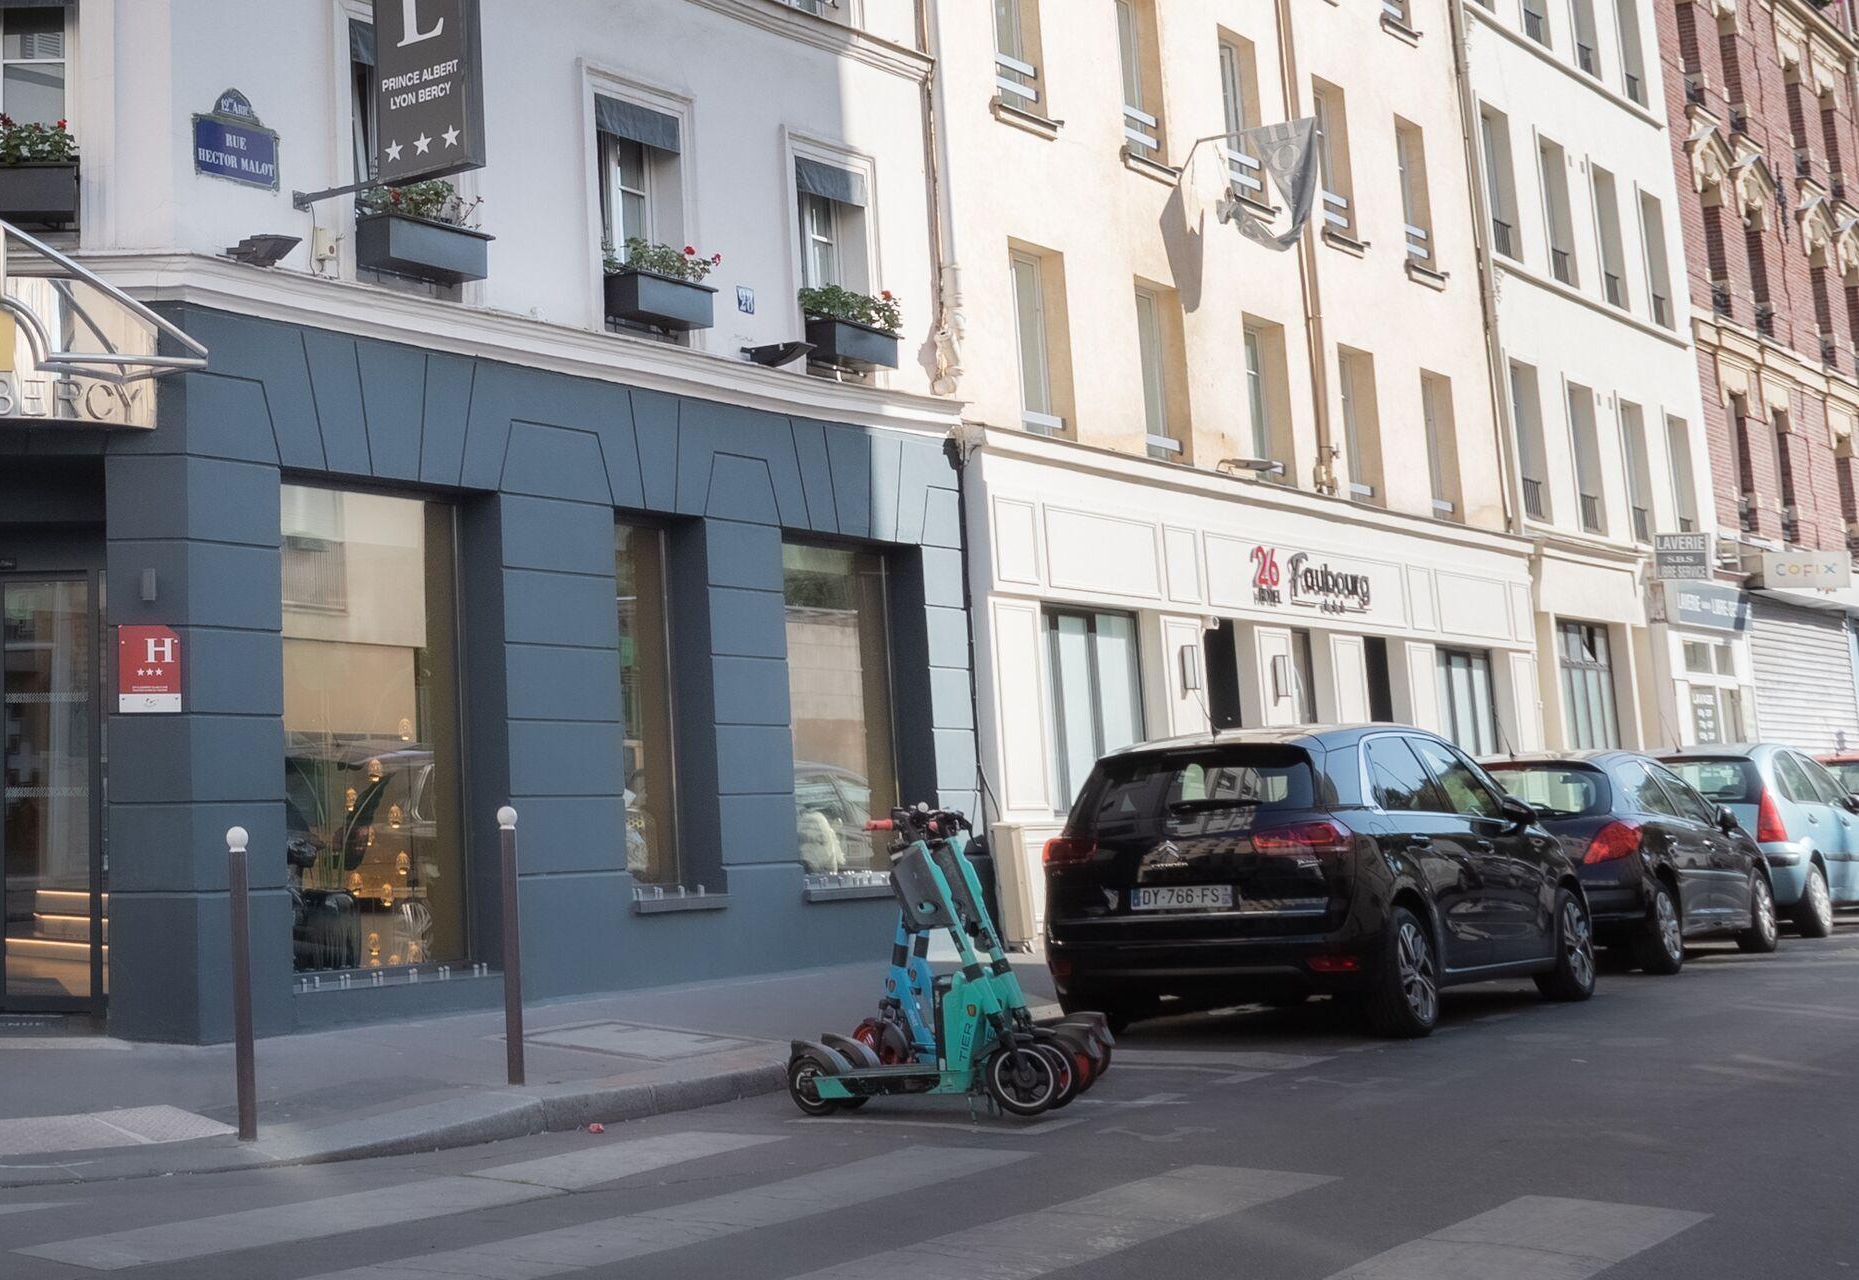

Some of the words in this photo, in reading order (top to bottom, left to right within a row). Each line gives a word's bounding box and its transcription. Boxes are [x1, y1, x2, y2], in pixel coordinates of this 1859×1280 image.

[381, 70, 420, 93] PRINCE
[421, 59, 459, 82] ALBERT
[390, 91, 416, 110] LYON
[418, 81, 452, 103] BERCY
[225, 133, 247, 151] RUE
[197, 147, 238, 169] HECTOR
[240, 157, 275, 177] MALOT
[1656, 536, 1705, 550] LAVERIE
[1250, 545, 1280, 588] 26
[1288, 552, 1370, 608] Faubourg
[1775, 562, 1837, 577] COFIX
[144, 637, 175, 663] H
[959, 1022, 973, 1062] TIER
